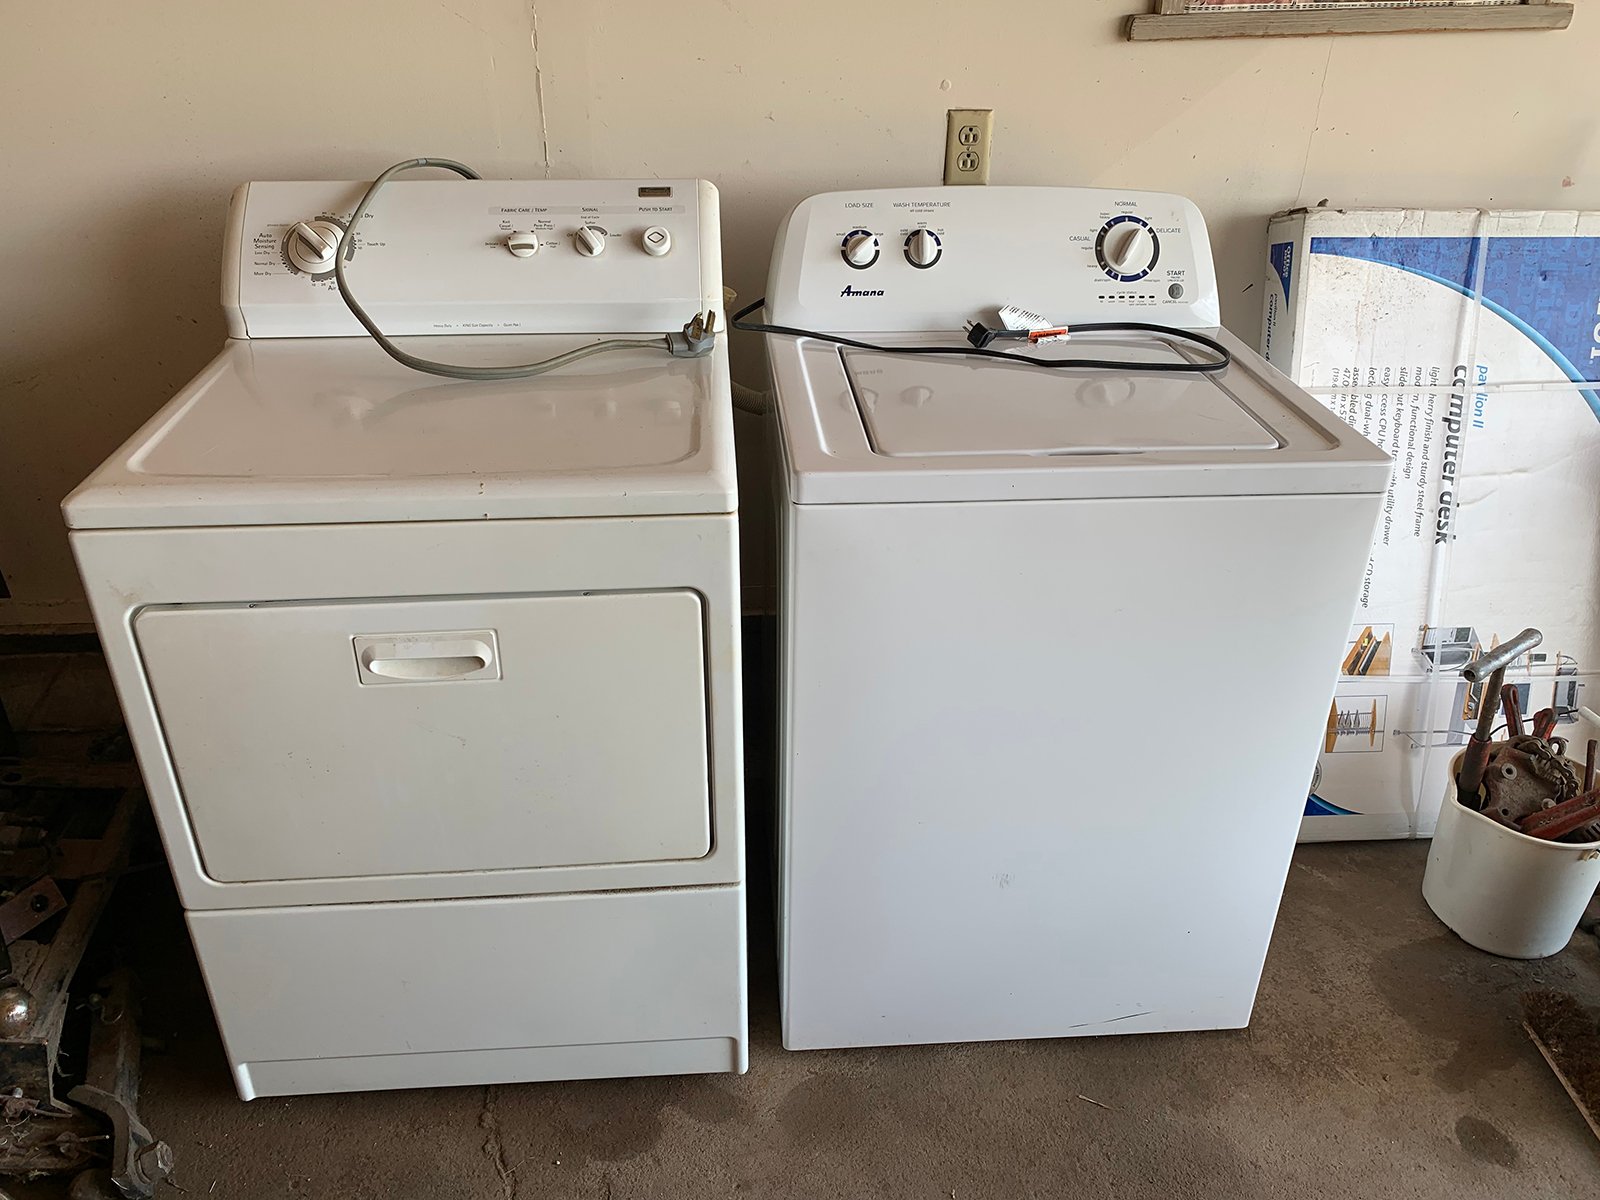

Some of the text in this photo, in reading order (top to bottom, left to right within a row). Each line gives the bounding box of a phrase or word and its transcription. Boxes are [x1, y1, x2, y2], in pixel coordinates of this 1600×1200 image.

[840, 285, 884, 297] Amana
[1265, 294, 1274, 350] computer
[1381, 366, 1391, 387] easy
[1380, 394, 1389, 416] ccess
[1378, 418, 1387, 437] CPU
[1392, 408, 1404, 448] keyboard
[1407, 404, 1419, 450] functional
[1403, 452, 1415, 479] design
[1414, 366, 1440, 537] light herry finish and sturdy steel frame
[1384, 489, 1395, 514] utility
[1383, 516, 1393, 545] drawer
[1435, 491, 1460, 545] desk
[1360, 577, 1371, 608] storage
